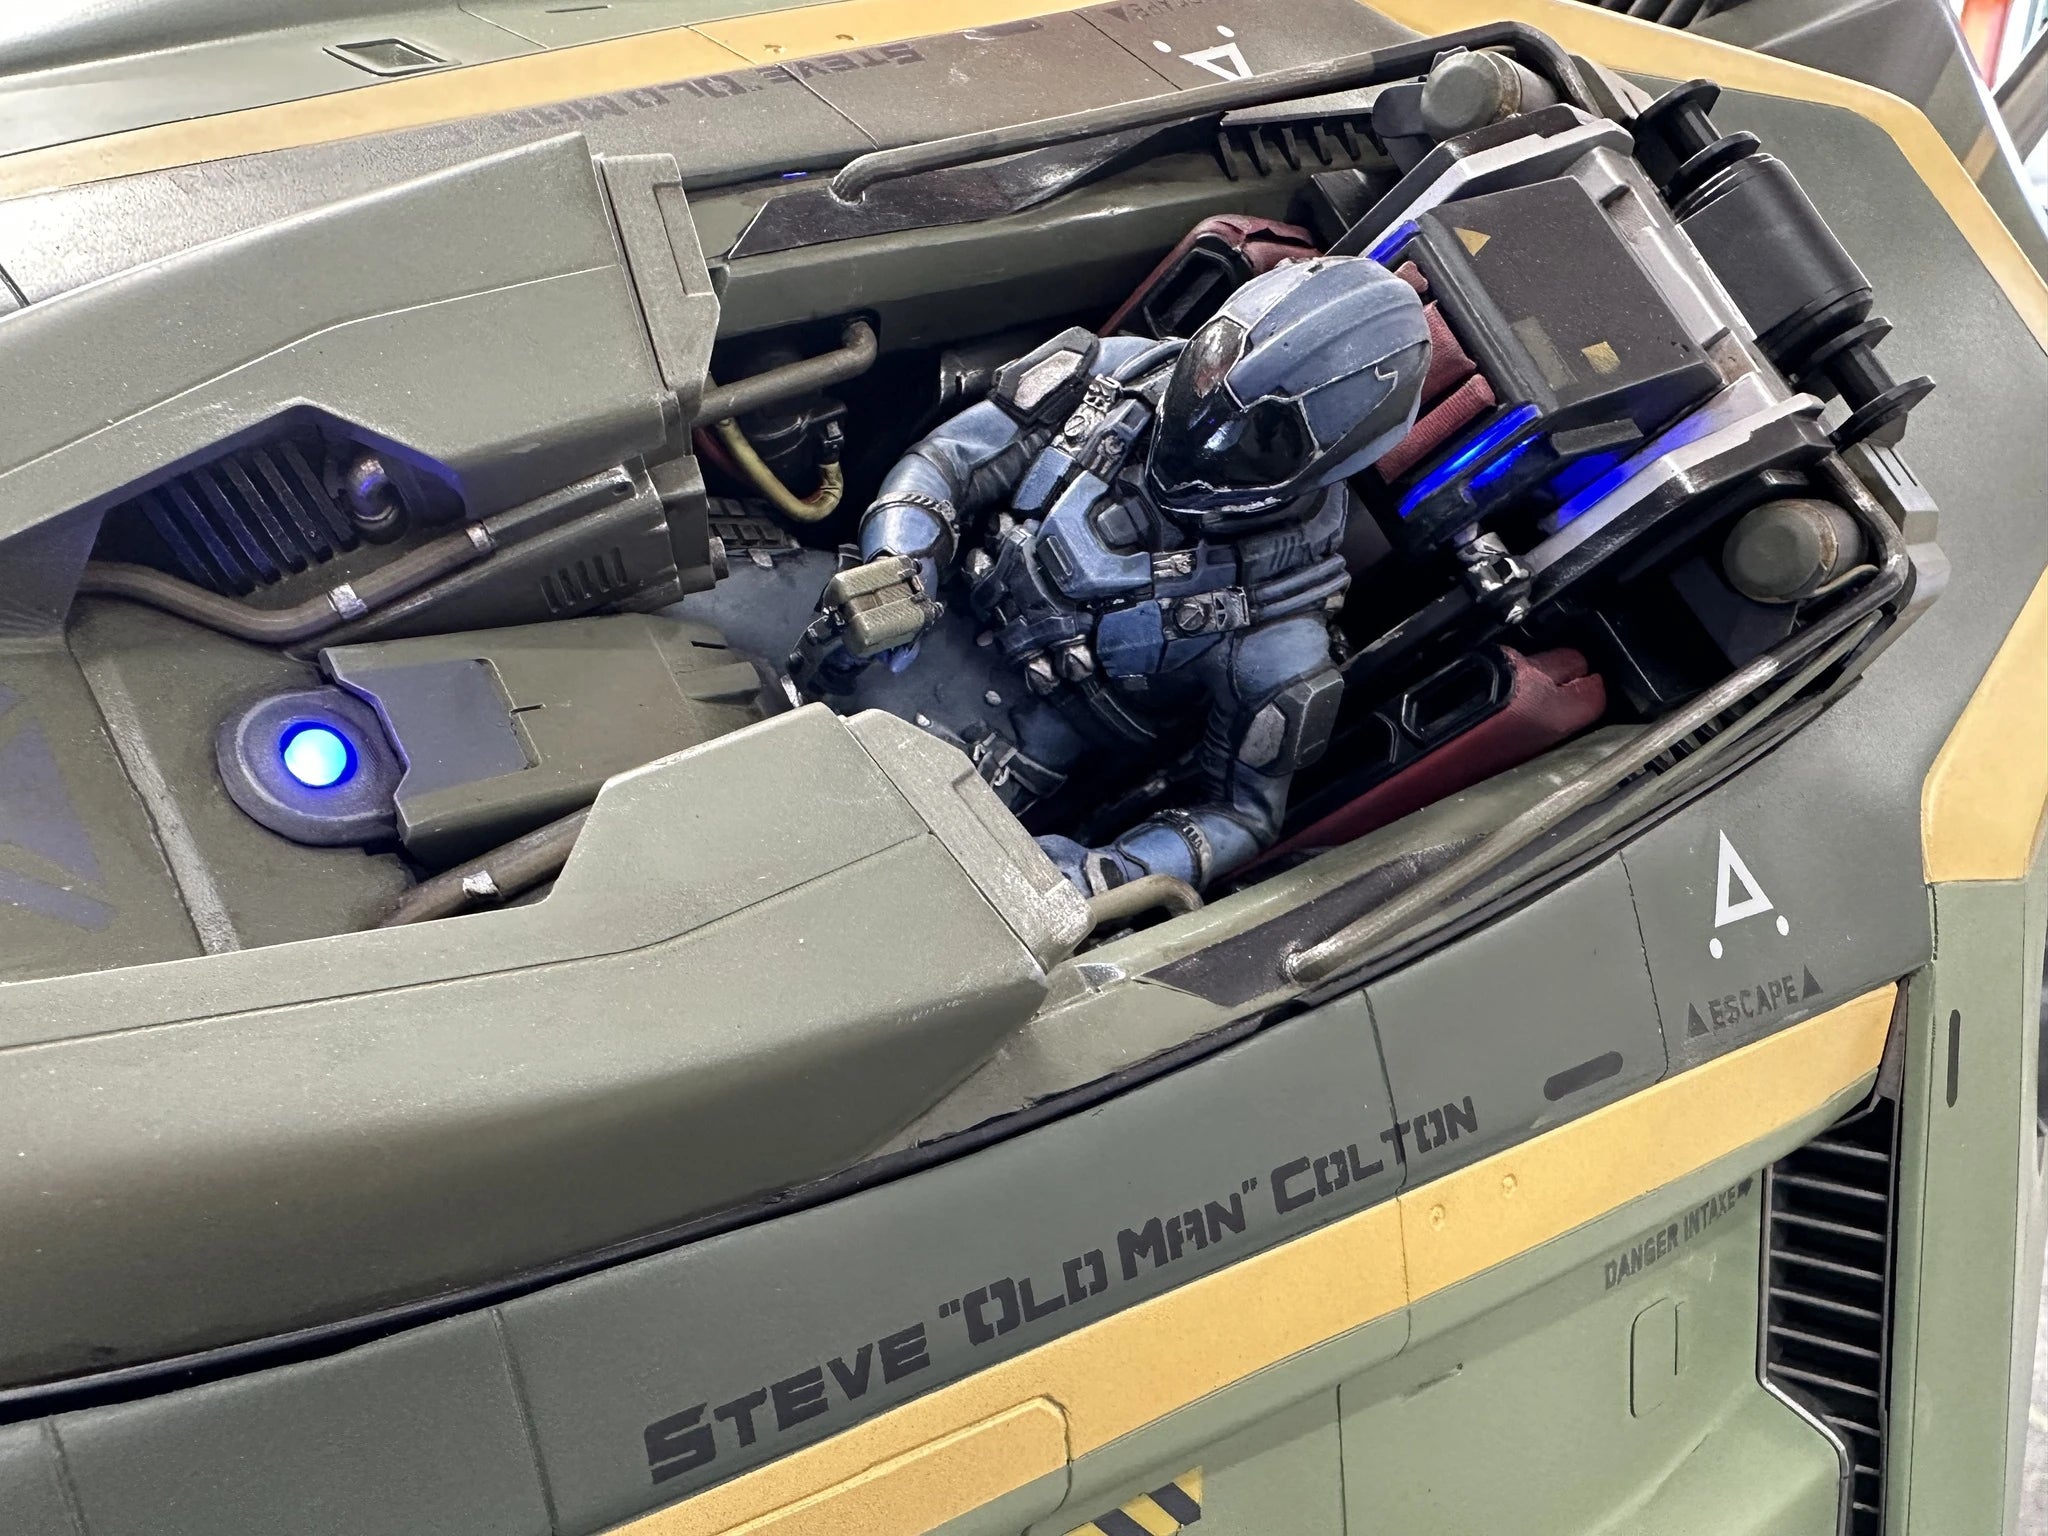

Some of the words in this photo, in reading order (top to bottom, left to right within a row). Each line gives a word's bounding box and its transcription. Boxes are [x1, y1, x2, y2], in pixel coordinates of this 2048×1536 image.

[1708, 975, 1799, 1030] ESCAPE
[643, 1322, 931, 1485] STEVE
[938, 1248, 1107, 1346] "OLD
[1117, 1178, 1258, 1281] MAN"
[1272, 1096, 1479, 1215] COLTON
[1604, 1222, 1679, 1291] DANGER
